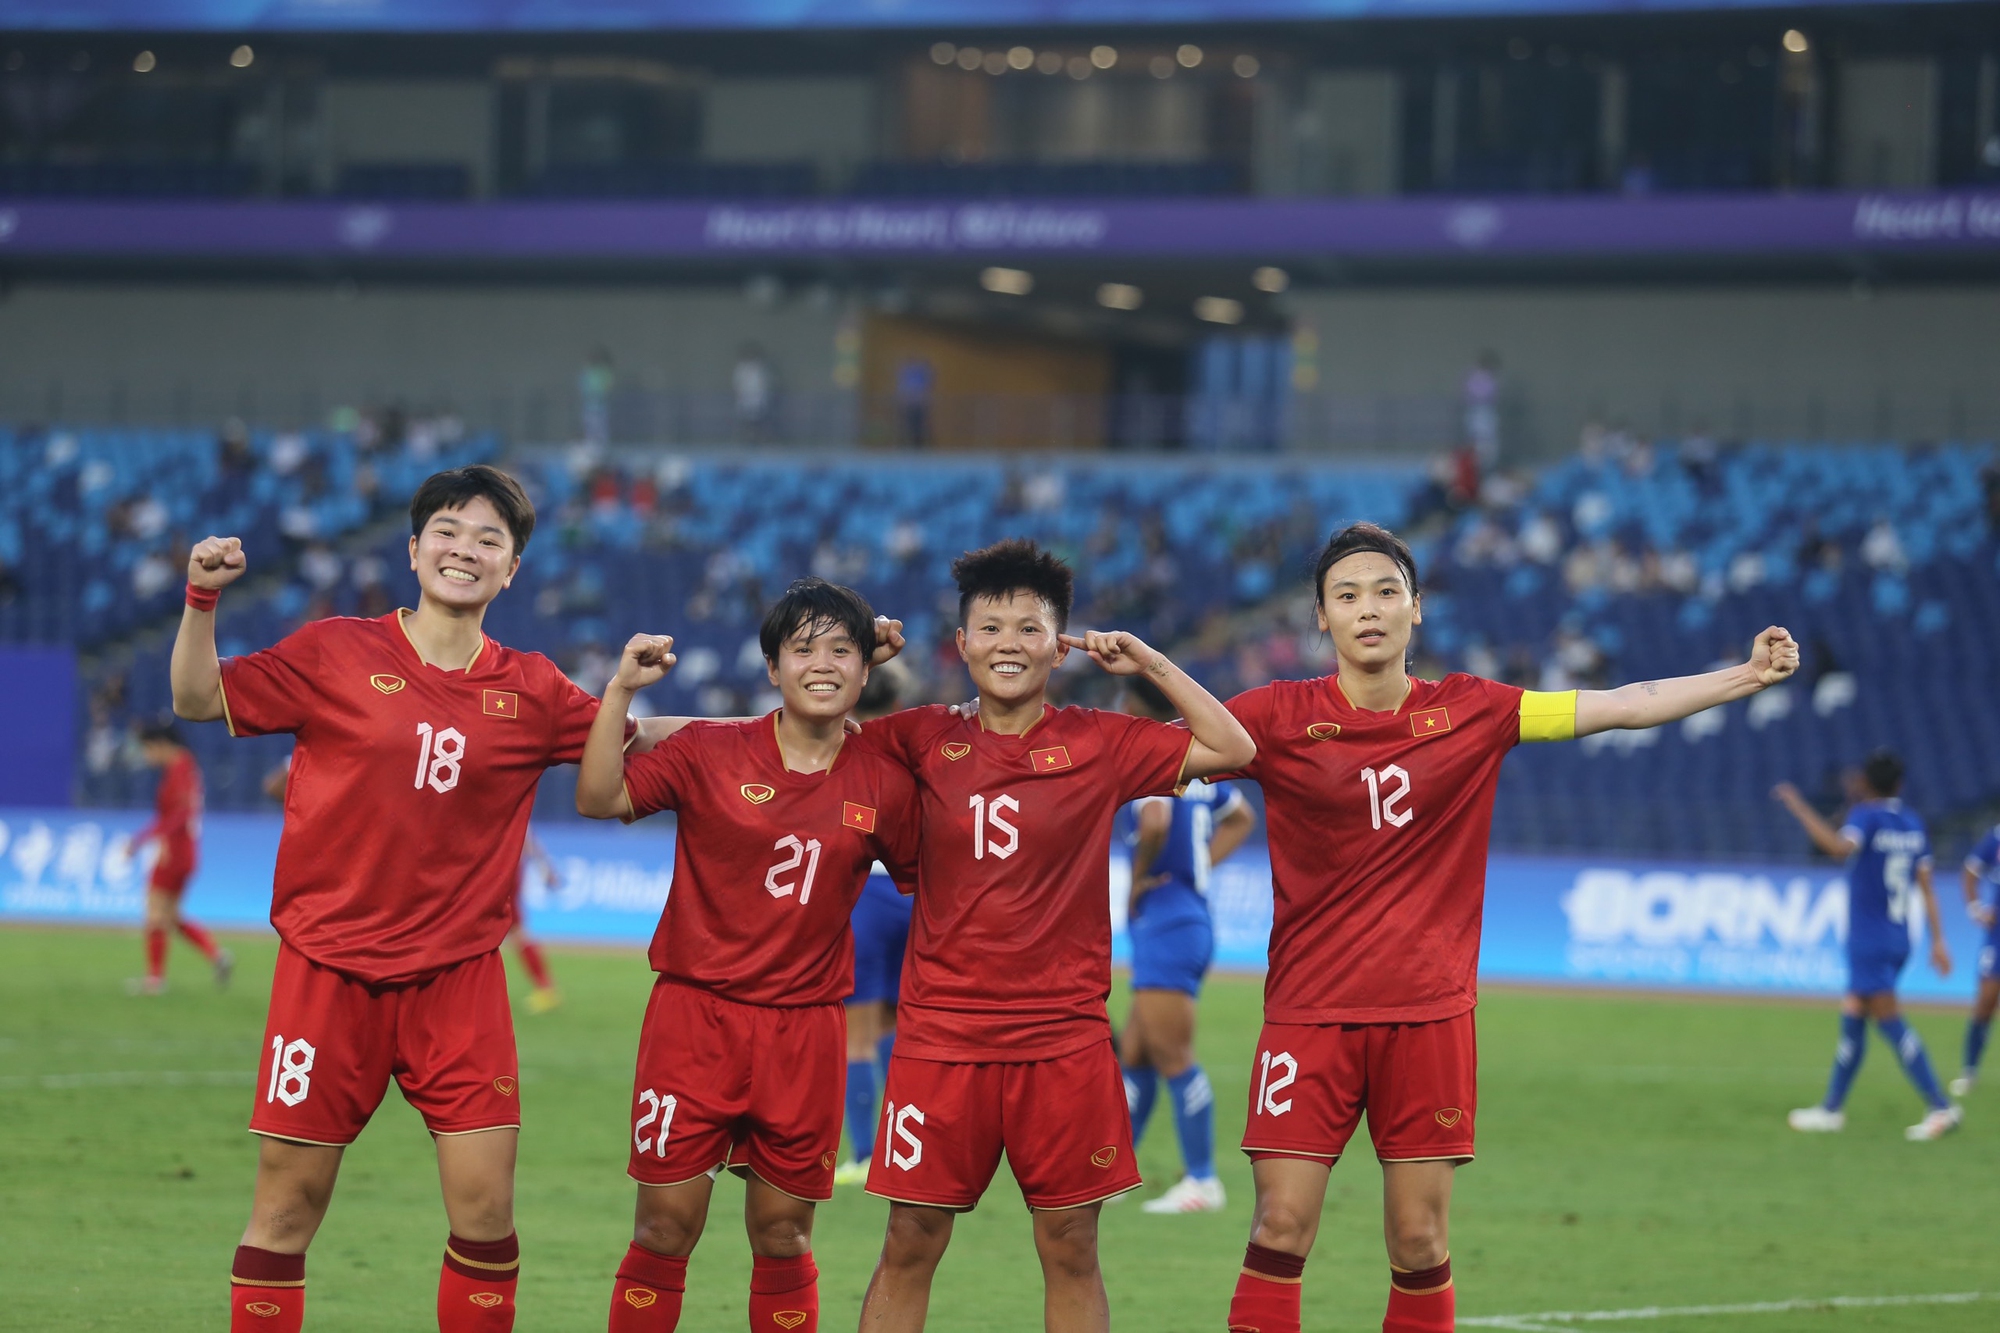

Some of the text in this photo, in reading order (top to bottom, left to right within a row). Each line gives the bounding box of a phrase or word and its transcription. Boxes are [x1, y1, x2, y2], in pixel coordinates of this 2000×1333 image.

[416, 722, 467, 794] 18
[969, 794, 1020, 860] 15
[1361, 764, 1413, 831] 12
[765, 835, 822, 905] 21
[268, 1035, 316, 1107] 18
[1257, 1051, 1298, 1117] 12
[635, 1089, 678, 1158] 21
[885, 1102, 925, 1171] 15
